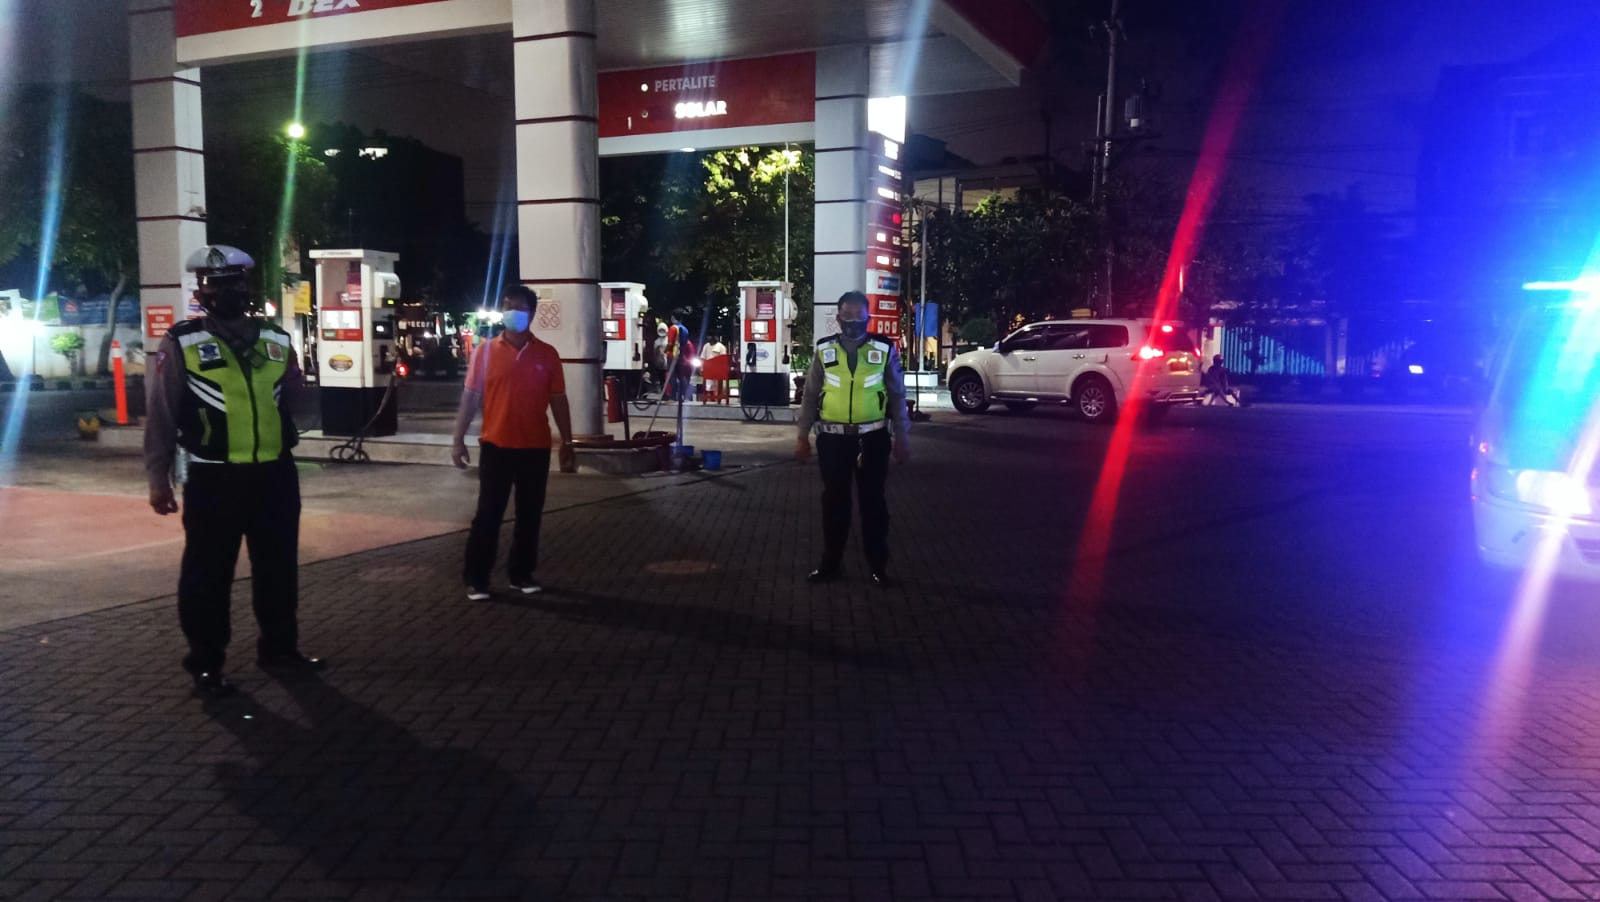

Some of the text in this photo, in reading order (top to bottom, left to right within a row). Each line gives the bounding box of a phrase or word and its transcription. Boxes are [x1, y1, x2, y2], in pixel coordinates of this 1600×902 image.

[250, 0, 262, 18] 2
[655, 76, 716, 92] PERTALITE
[675, 101, 727, 119] SOLAR
